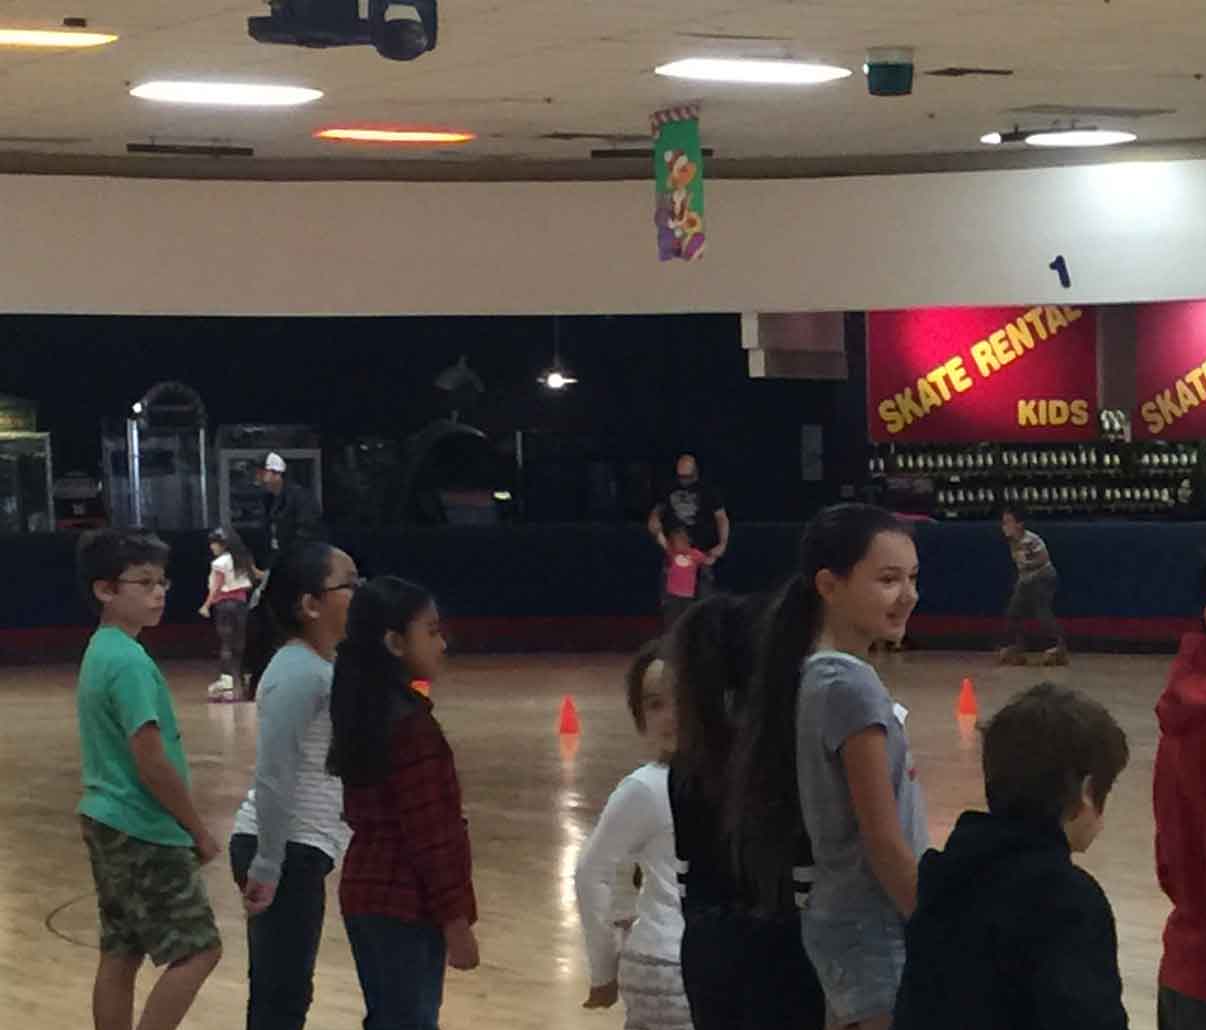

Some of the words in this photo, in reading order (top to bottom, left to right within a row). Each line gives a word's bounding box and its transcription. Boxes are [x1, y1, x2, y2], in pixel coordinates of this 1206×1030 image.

[878, 355, 973, 433] SKATE
[970, 305, 1082, 377] RENTAL
[1017, 399, 1089, 426] KIDS
